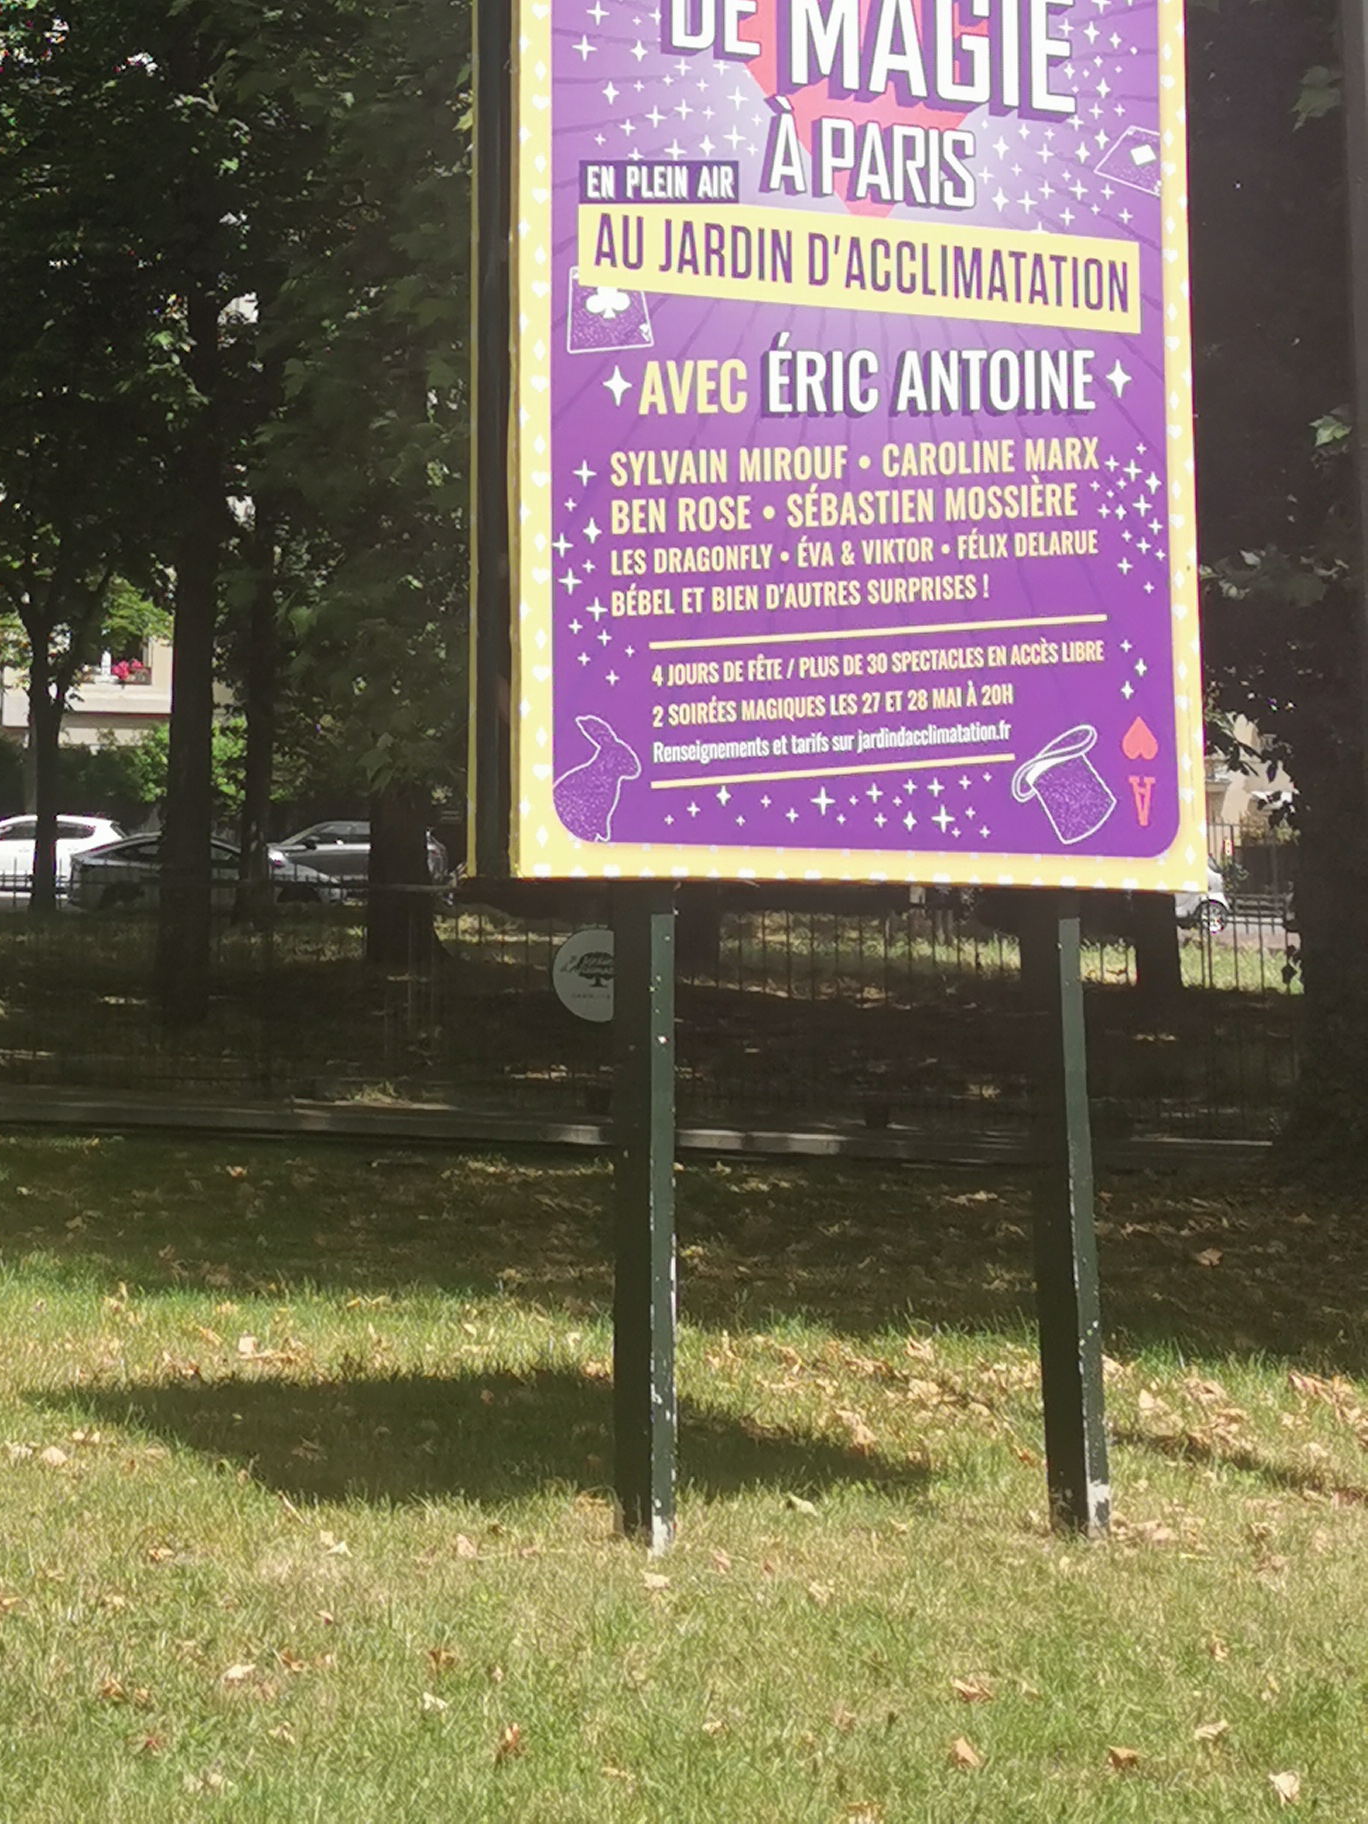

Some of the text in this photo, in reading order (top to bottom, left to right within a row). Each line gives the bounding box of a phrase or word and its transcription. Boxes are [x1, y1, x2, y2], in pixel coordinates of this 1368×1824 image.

[768, 94, 977, 209] À PARIS
[586, 165, 736, 200] EN PLEIN AIR
[594, 212, 1129, 313] AU JARDIN D'ACCLIMATATION
[638, 330, 1097, 415] AVEC ÉRIC ANTOINE
[610, 436, 1099, 487] SYLVAIN MIROUF CAROLINE MARX
[611, 474, 1078, 535] BEN ROSE SÉBASTIEN MOSSIÈRE
[611, 528, 1099, 576] LES DRAGONFLY ÉVA & VIKTOR FÉLIX DELARUE
[611, 583, 675, 617] BÉBEL
[682, 587, 705, 614] ET
[711, 584, 758, 612] BIEN
[766, 580, 861, 610] D'AUTRES
[867, 574, 977, 604] SURPRISES
[651, 665, 663, 687] 4
[667, 661, 719, 686] JOURS
[723, 660, 744, 683] DE
[748, 653, 782, 682] FÊTE
[799, 655, 840, 679] PLUS
[843, 654, 864, 676] DE
[867, 652, 887, 675] 30
[891, 645, 983, 673] SPECTACLES
[988, 645, 1007, 667] EN
[1010, 637, 1059, 665] ACCÈS
[1062, 639, 1104, 663] LIBRE
[652, 680, 1013, 728] 2 SOIRÉES MAGIQUES LES 27 ET 28 MAI À 20H
[653, 720, 1012, 764] Renseignements et tarifs sur jardindacclimatation.fr
